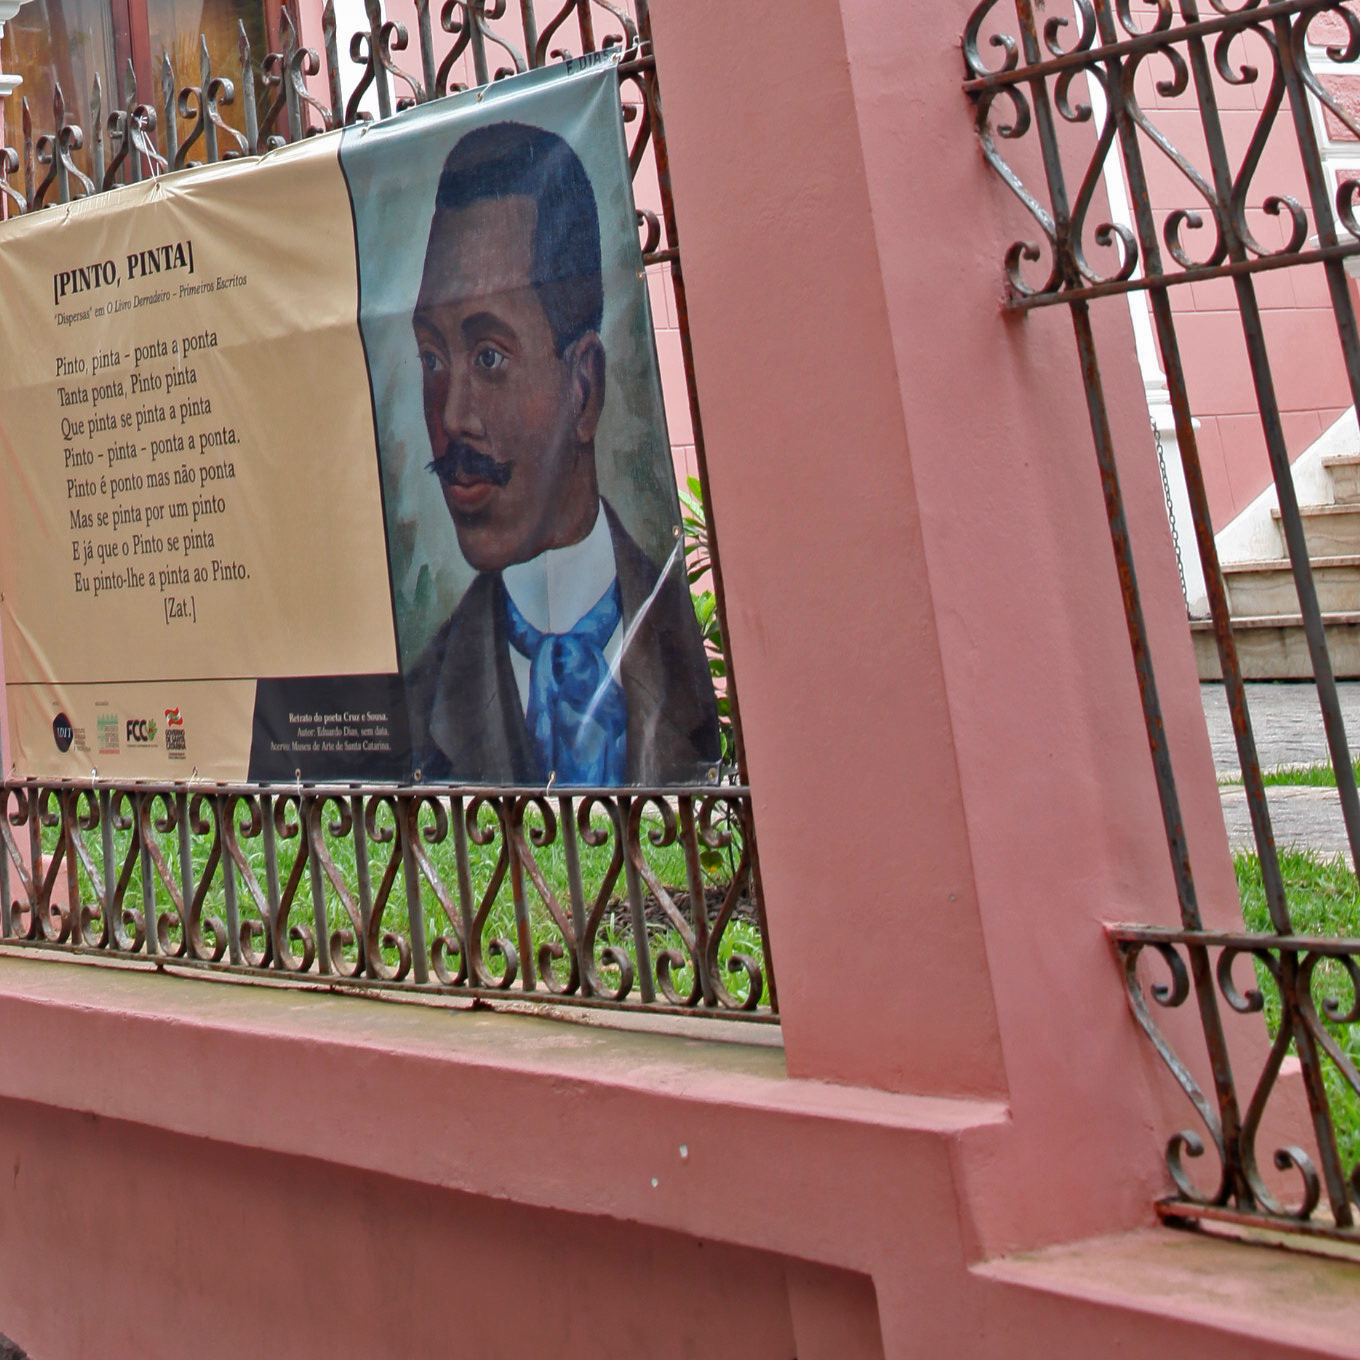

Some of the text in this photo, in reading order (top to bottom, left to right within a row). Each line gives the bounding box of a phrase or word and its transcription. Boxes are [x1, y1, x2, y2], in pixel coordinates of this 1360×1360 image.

[53, 240, 194, 306] [PINTO, PINTA]
[94, 307, 105, 318] em
[106, 301, 113, 314] O
[114, 298, 132, 313] Livro
[133, 289, 171, 308] Derradeiro
[179, 281, 215, 298] Primeiros
[216, 274, 248, 290] Escritos
[55, 356, 89, 377] Pinto,
[92, 347, 121, 376] pinta
[134, 339, 168, 368] ponta
[171, 339, 178, 354] a
[182, 330, 218, 359] ponta
[56, 366, 197, 408] Tanta ponta, Pinto pinta
[61, 396, 212, 441] Que pinta se pinta a pinta
[63, 447, 94, 468] Pinto
[107, 440, 138, 468] pinta
[150, 433, 185, 462] ponta
[188, 435, 195, 450] a
[199, 426, 241, 455] ponta.
[67, 459, 236, 499] Pinto é ponto mas não ponta
[69, 494, 226, 531] Mas se pinta por um pinto
[72, 529, 215, 566] E já que o Pinto se pinta
[74, 559, 251, 597] Eu pinto-lhe a pinta ao Pinto.
[163, 595, 197, 625] [Zat.]
[126, 719, 148, 742] FCC
[289, 713, 313, 723] Retrato
[313, 712, 323, 722] do
[323, 713, 342, 725] poeta
[343, 711, 360, 722] Cruz
[361, 713, 366, 721] e
[317, 726, 342, 737] Eduardo
[360, 728, 374, 736] sem
[292, 741, 312, 751] Museu
[312, 741, 321, 751] de
[322, 741, 335, 751] Arte
[335, 741, 344, 750] de
[344, 740, 362, 751] Santa
